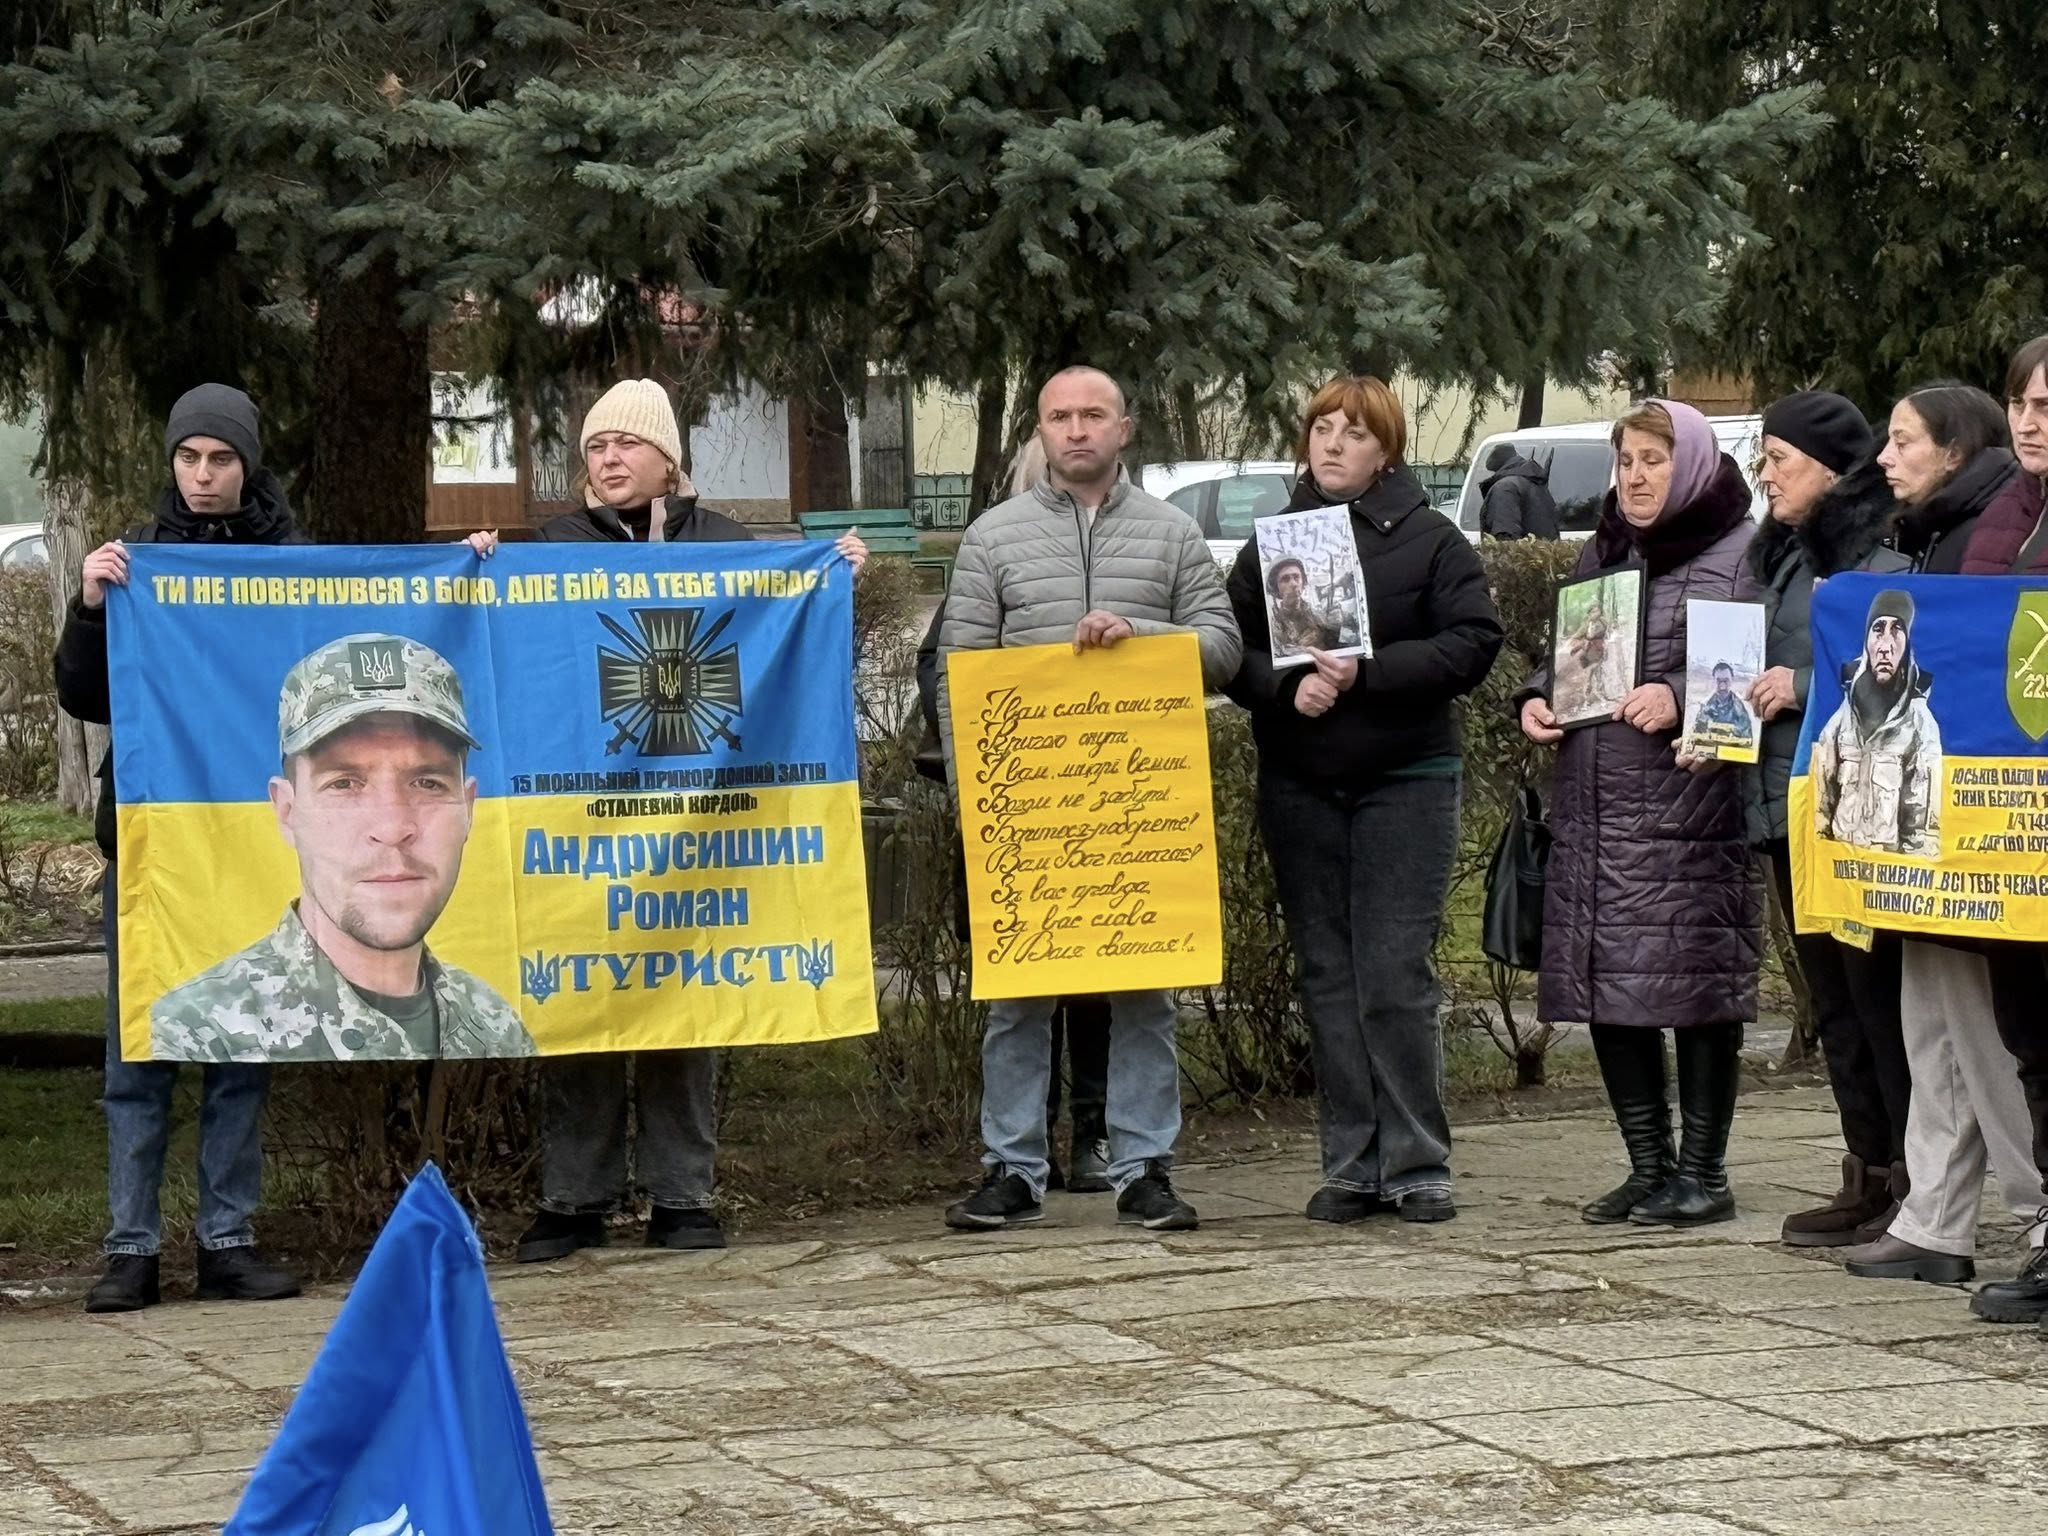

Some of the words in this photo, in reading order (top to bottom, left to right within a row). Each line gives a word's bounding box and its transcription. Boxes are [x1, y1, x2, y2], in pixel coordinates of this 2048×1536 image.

[152, 576, 186, 605] ТИ
[193, 576, 225, 605] НЕ
[231, 576, 404, 605] ПОВЕРНУВСЯ
[410, 577, 429, 604] З
[434, 576, 502, 607] БОЮ,
[506, 573, 557, 603] АЛЕ
[563, 567, 609, 600] БІЙ
[615, 572, 651, 599] ЗА
[654, 571, 717, 599] ТЕБЕ
[1053, 690, 1110, 718] слава
[511, 774, 531, 794] 15
[535, 767, 640, 793] МОБІЛЬНИЙ
[644, 762, 775, 789] ПРИКОРДОННИЙ
[778, 762, 827, 783] ЗАГІН
[586, 793, 684, 818] «СТАЛЕВИЙ
[688, 792, 758, 816] КОРДОН»
[977, 781, 1050, 813] Богом
[1056, 793, 1086, 809] не
[523, 825, 823, 881] Андрусишин
[986, 843, 1050, 873] Вам
[1054, 839, 1105, 868] Бог
[991, 874, 1023, 904] За
[1030, 874, 1067, 902] вас
[1877, 863, 1935, 890] ЖИВИМ
[1967, 872, 2000, 894] ТЕБЕ
[607, 884, 749, 931] Роман
[993, 901, 1029, 933] За
[1041, 904, 1083, 931] вас
[1091, 898, 1158, 927] слава
[560, 942, 798, 992] ТУРИСТ
